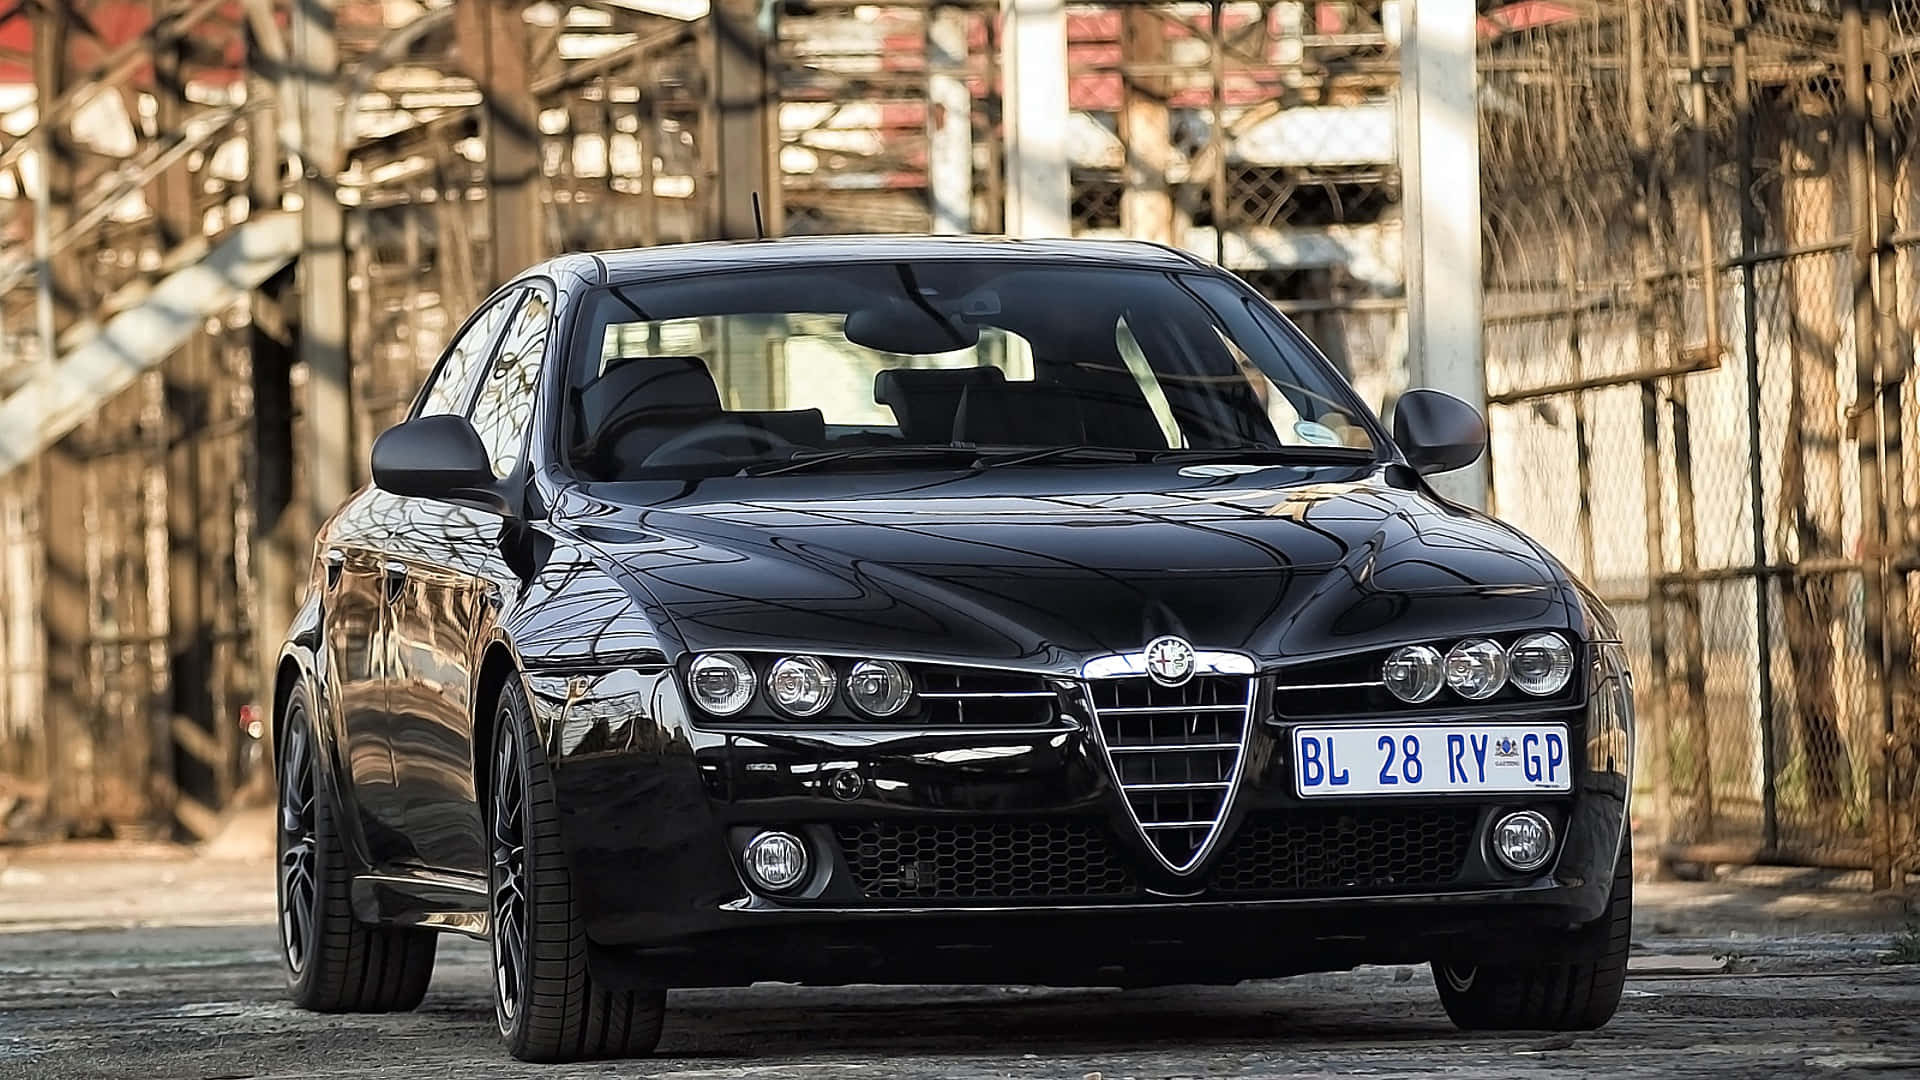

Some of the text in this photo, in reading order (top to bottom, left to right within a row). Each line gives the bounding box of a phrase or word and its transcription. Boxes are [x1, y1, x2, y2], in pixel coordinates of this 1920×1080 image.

[1301, 733, 1563, 786] BL 28 RY GP
